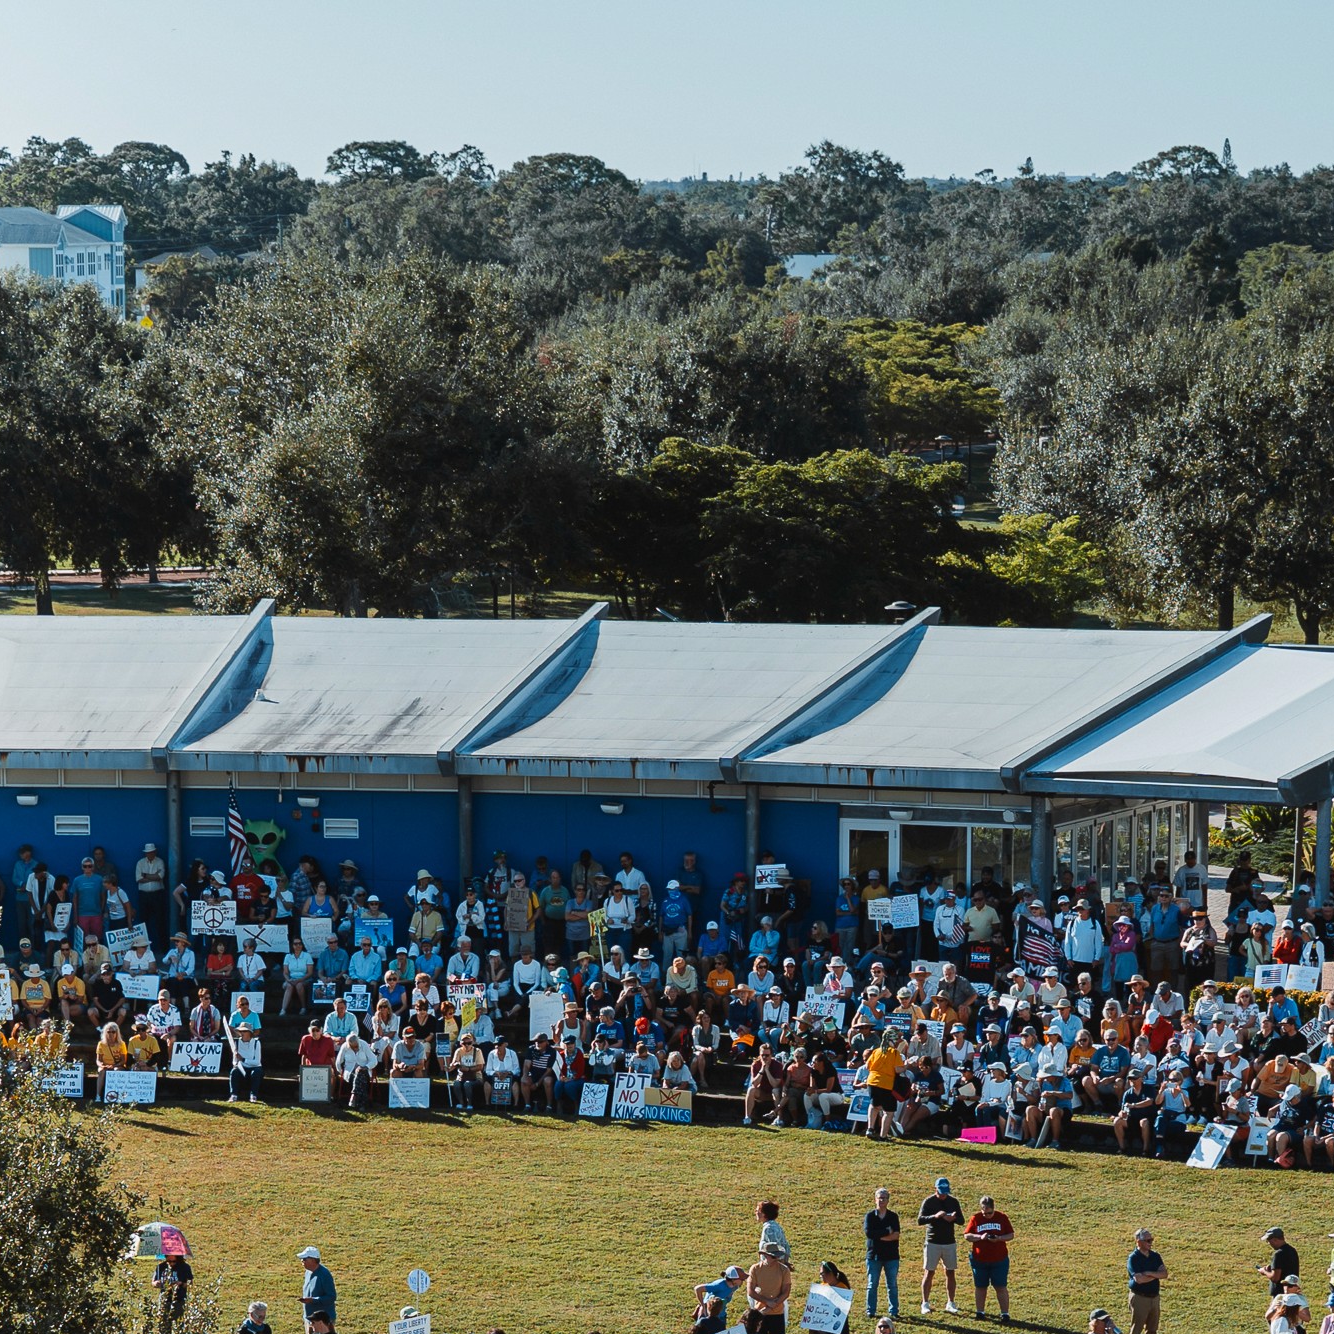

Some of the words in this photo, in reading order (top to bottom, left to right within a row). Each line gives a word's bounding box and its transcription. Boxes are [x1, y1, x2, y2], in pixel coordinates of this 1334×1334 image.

[971, 945, 992, 954] LOVE
[969, 962, 989, 970] HATE
[449, 985, 464, 996] SAY
[464, 984, 475, 995] NO
[804, 1001, 841, 1011] SUPPORT
[175, 1043, 193, 1055] NO
[494, 1082, 511, 1091] OFF!
[615, 1073, 651, 1090] FDT
[618, 1089, 640, 1105] NO
[614, 1103, 645, 1121] KINGS
[645, 1105, 658, 1118] NO
[660, 1106, 692, 1122] KINGS
[393, 1321, 408, 1332] YOUR
[408, 1317, 427, 1329] LIBERTY
